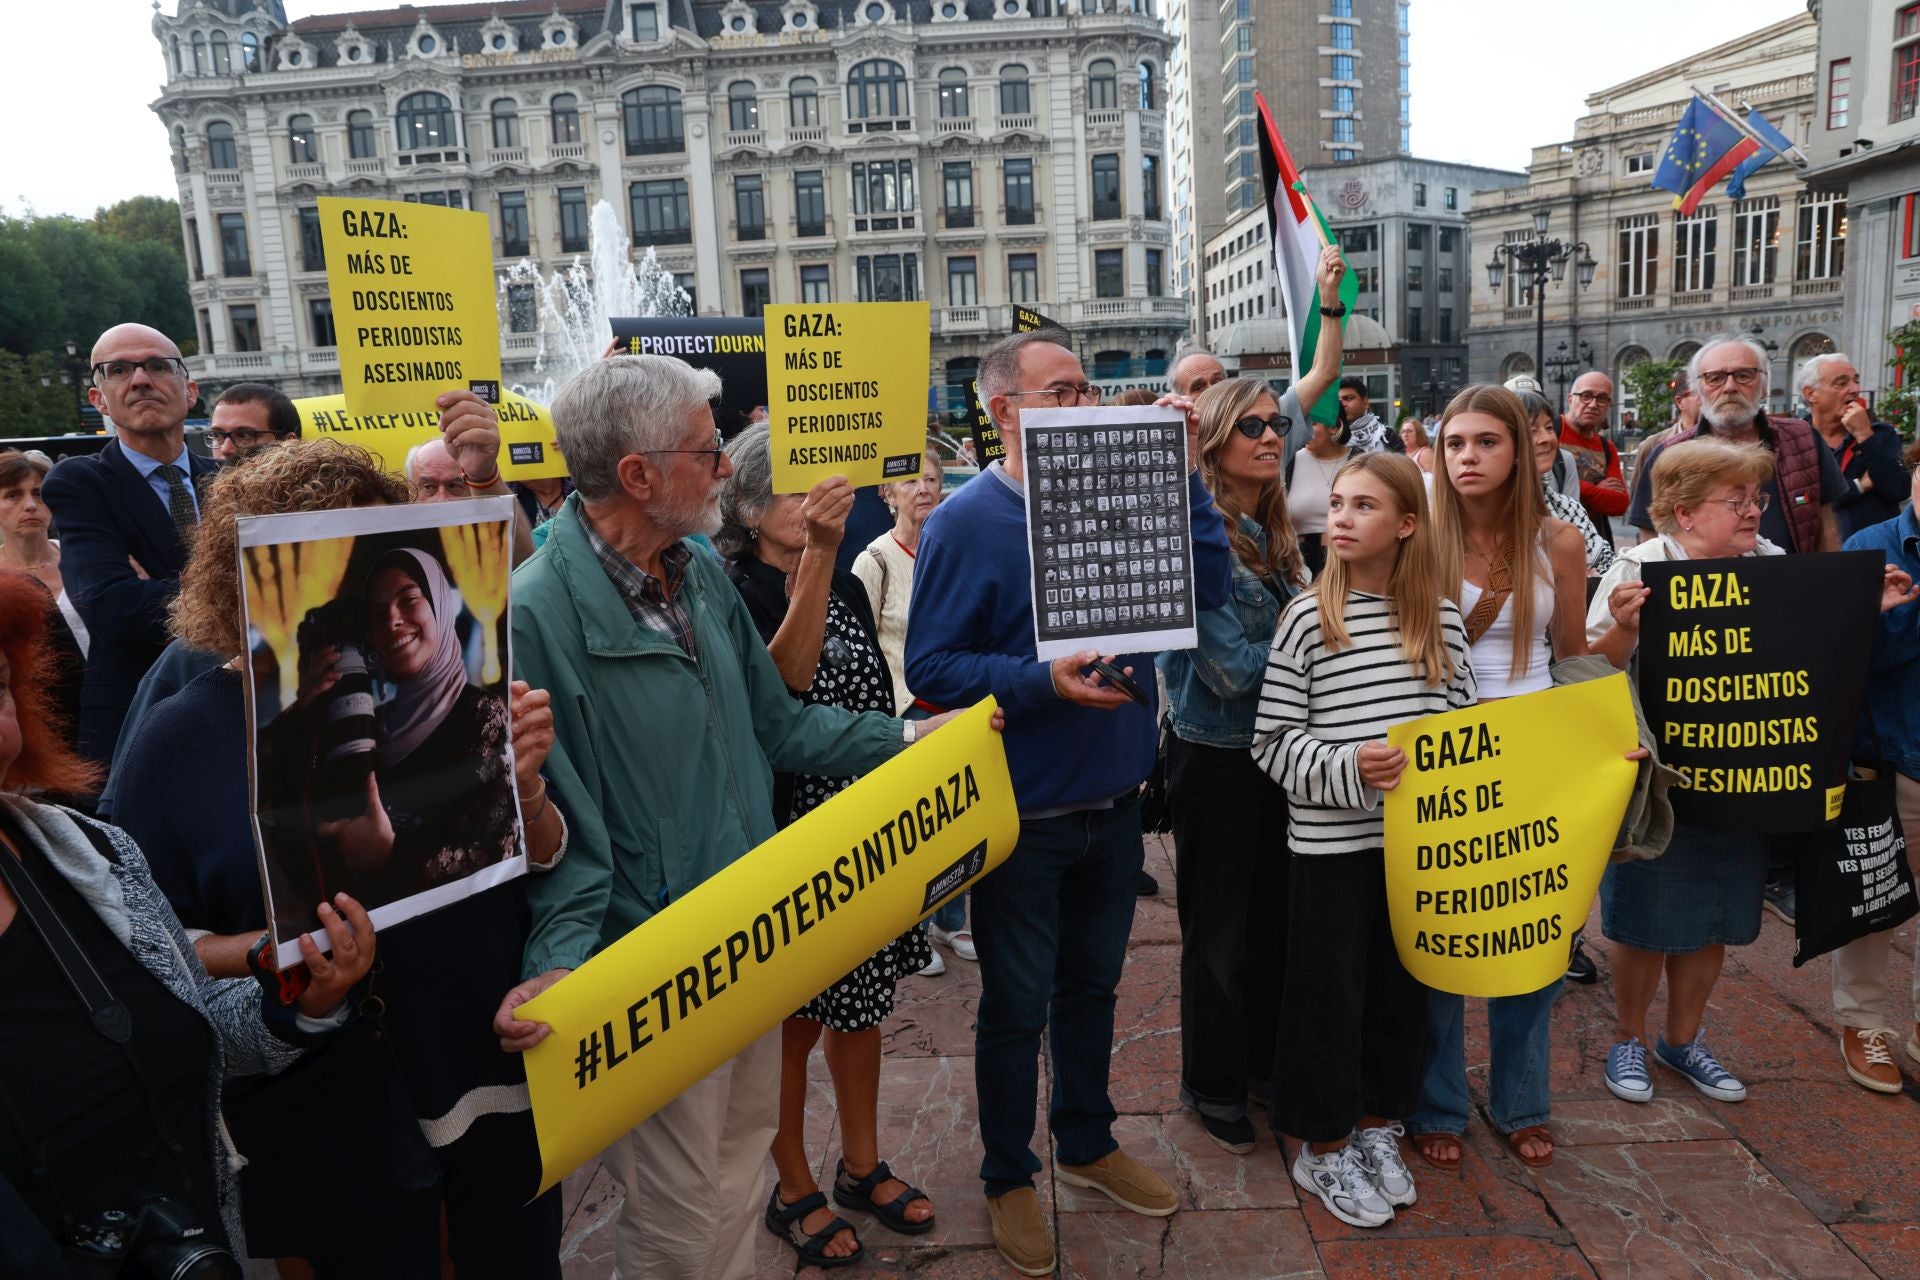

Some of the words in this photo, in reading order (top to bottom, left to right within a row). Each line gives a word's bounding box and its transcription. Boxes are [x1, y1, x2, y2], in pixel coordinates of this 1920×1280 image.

[342, 210, 408, 239] GAZA:
[347, 250, 385, 274] MÁS
[390, 255, 412, 275] DE
[352, 290, 454, 312] DOSCIENTOS
[784, 313, 842, 338] GAZA:
[1020, 310, 1041, 327] GAZA:
[1664, 320, 1724, 335] TEATRO
[1738, 312, 1841, 331] CAMPOAMOR
[357, 326, 463, 348] PERIODISTAS
[785, 348, 818, 370] MÁS
[823, 351, 842, 369] DE
[363, 361, 463, 384] ASESINADOS
[786, 380, 879, 402] DOSCIENTOS
[788, 411, 883, 434] PERIODISTAS
[788, 442, 878, 466] ASESINADOS
[1669, 572, 1751, 610] GAZA:
[1668, 625, 1718, 658] MÁS
[1725, 627, 1753, 655] DE
[1666, 670, 1810, 703] DOSCIENTOS
[1664, 716, 1819, 748] PERIODISTAS
[1415, 722, 1501, 772] GAZA:
[1667, 763, 1812, 794] SESINADOS
[1416, 785, 1468, 824] MÁS
[1476, 780, 1504, 813] DE
[1417, 816, 1560, 871] DOSCIENTOS
[1844, 827, 1866, 841] YES
[1847, 843, 1868, 857] YES
[1836, 859, 1859, 873] YES
[930, 863, 965, 898] AMNISTÍA
[1415, 863, 1569, 915] PERIODISTAS
[1862, 872, 1875, 886] NO
[1863, 887, 1874, 901] NO
[1851, 904, 1864, 918] NO
[574, 763, 981, 1090] #LETREPOTERSINTOGAZA
[1414, 913, 1562, 958] ASESINADOS
